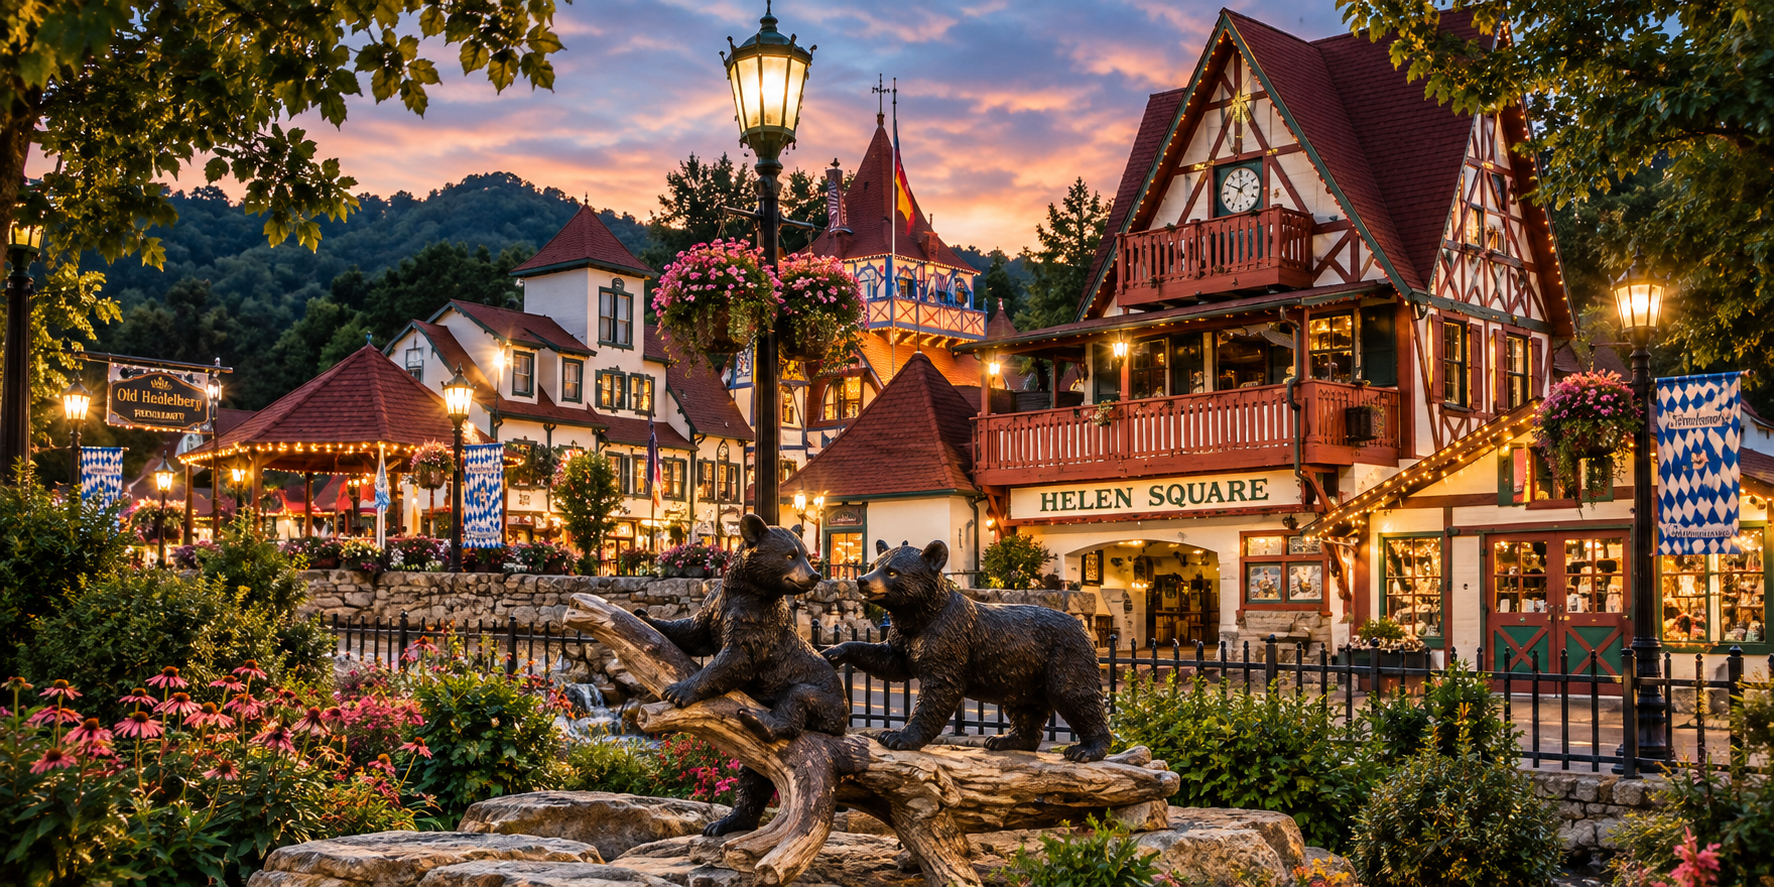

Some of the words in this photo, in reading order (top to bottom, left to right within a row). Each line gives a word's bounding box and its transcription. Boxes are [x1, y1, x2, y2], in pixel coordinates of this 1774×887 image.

[117, 388, 138, 402] Old
[1040, 487, 1133, 512] HELEN
[1148, 478, 1269, 508] SQUARE
